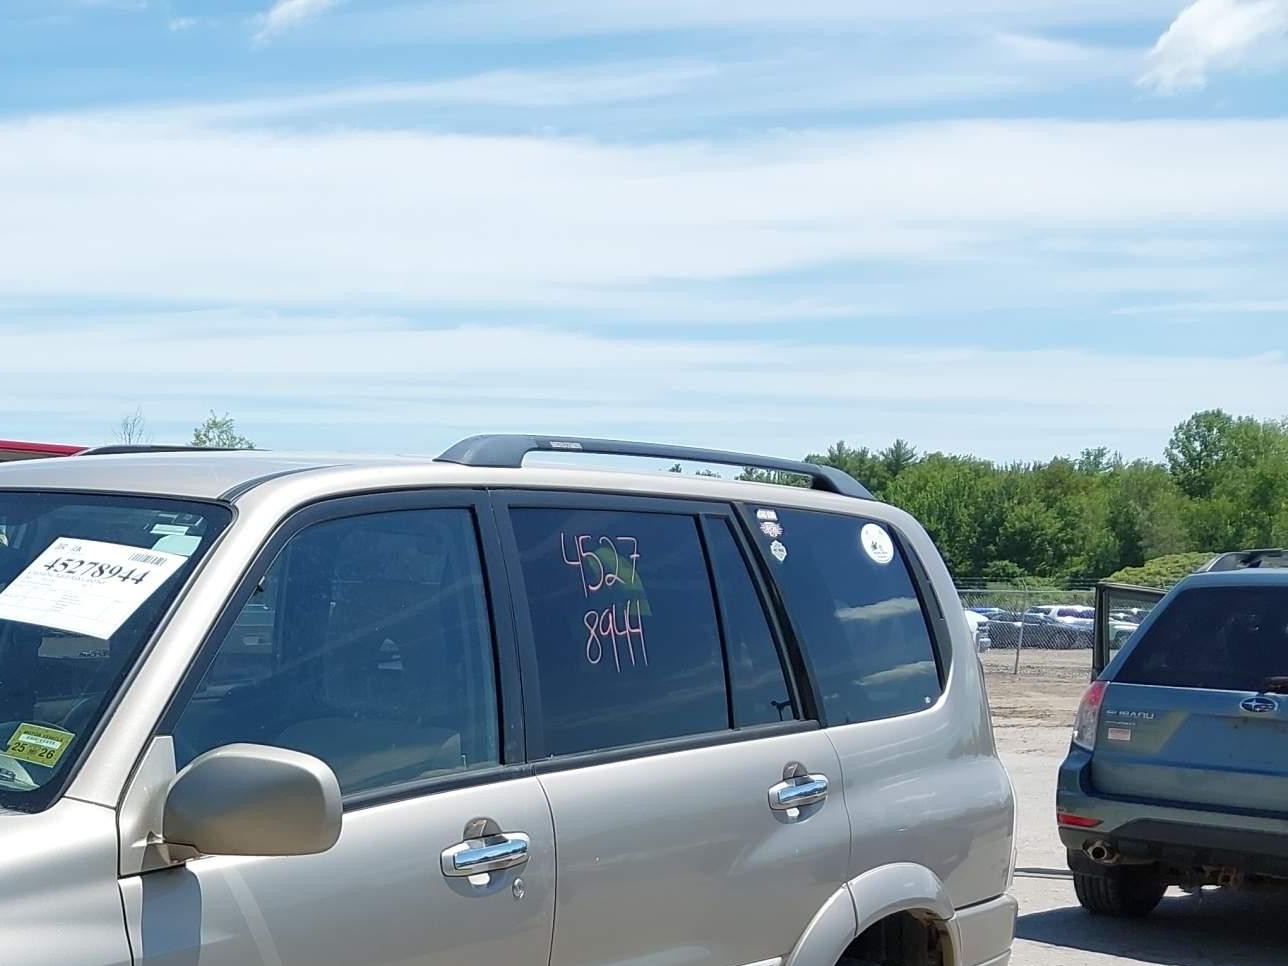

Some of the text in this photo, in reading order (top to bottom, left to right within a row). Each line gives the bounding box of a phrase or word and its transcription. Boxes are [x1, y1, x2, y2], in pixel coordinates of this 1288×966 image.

[44, 556, 151, 585] 45278944
[560, 532, 640, 599] 4527
[583, 599, 649, 674] 8944
[11, 741, 56, 760] 25 26
